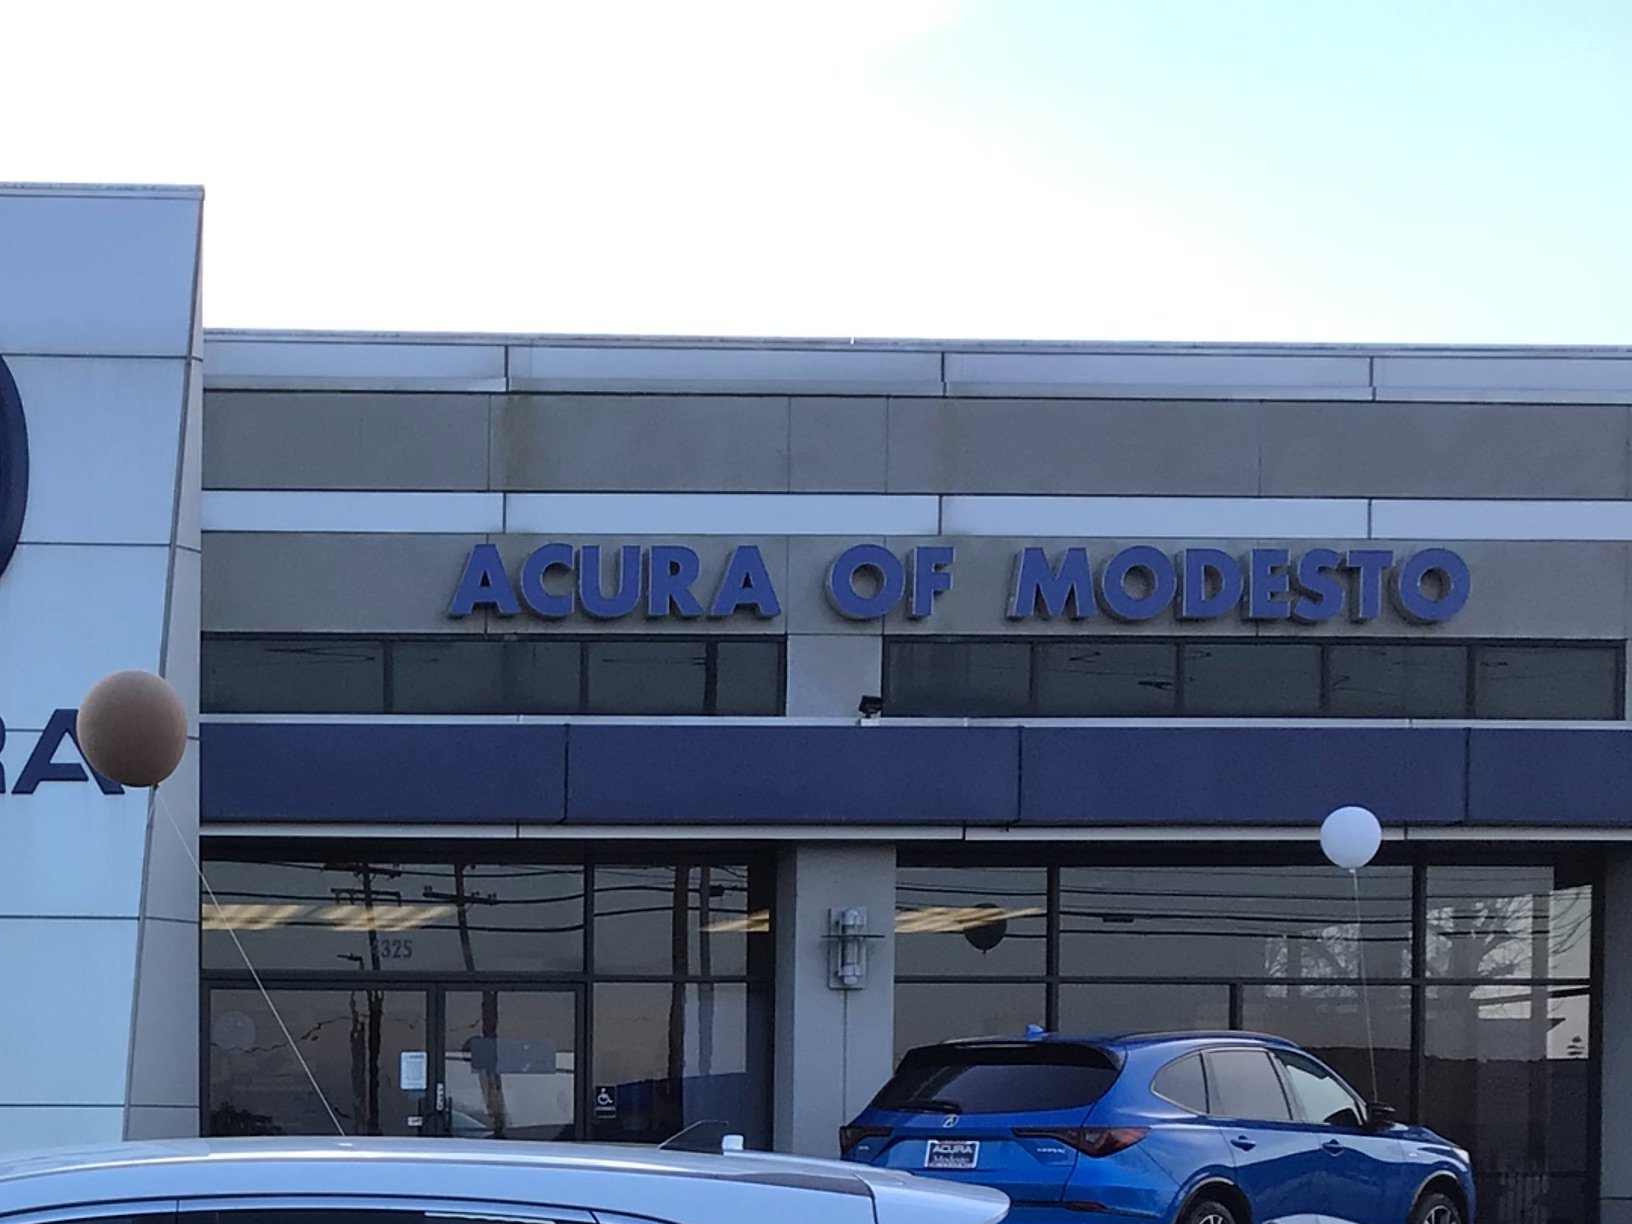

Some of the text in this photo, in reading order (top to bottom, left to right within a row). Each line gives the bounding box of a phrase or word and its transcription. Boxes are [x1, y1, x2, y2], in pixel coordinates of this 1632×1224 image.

[447, 543, 1472, 624] ACURA OF MODESTO
[932, 1144, 973, 1153] ACURA
